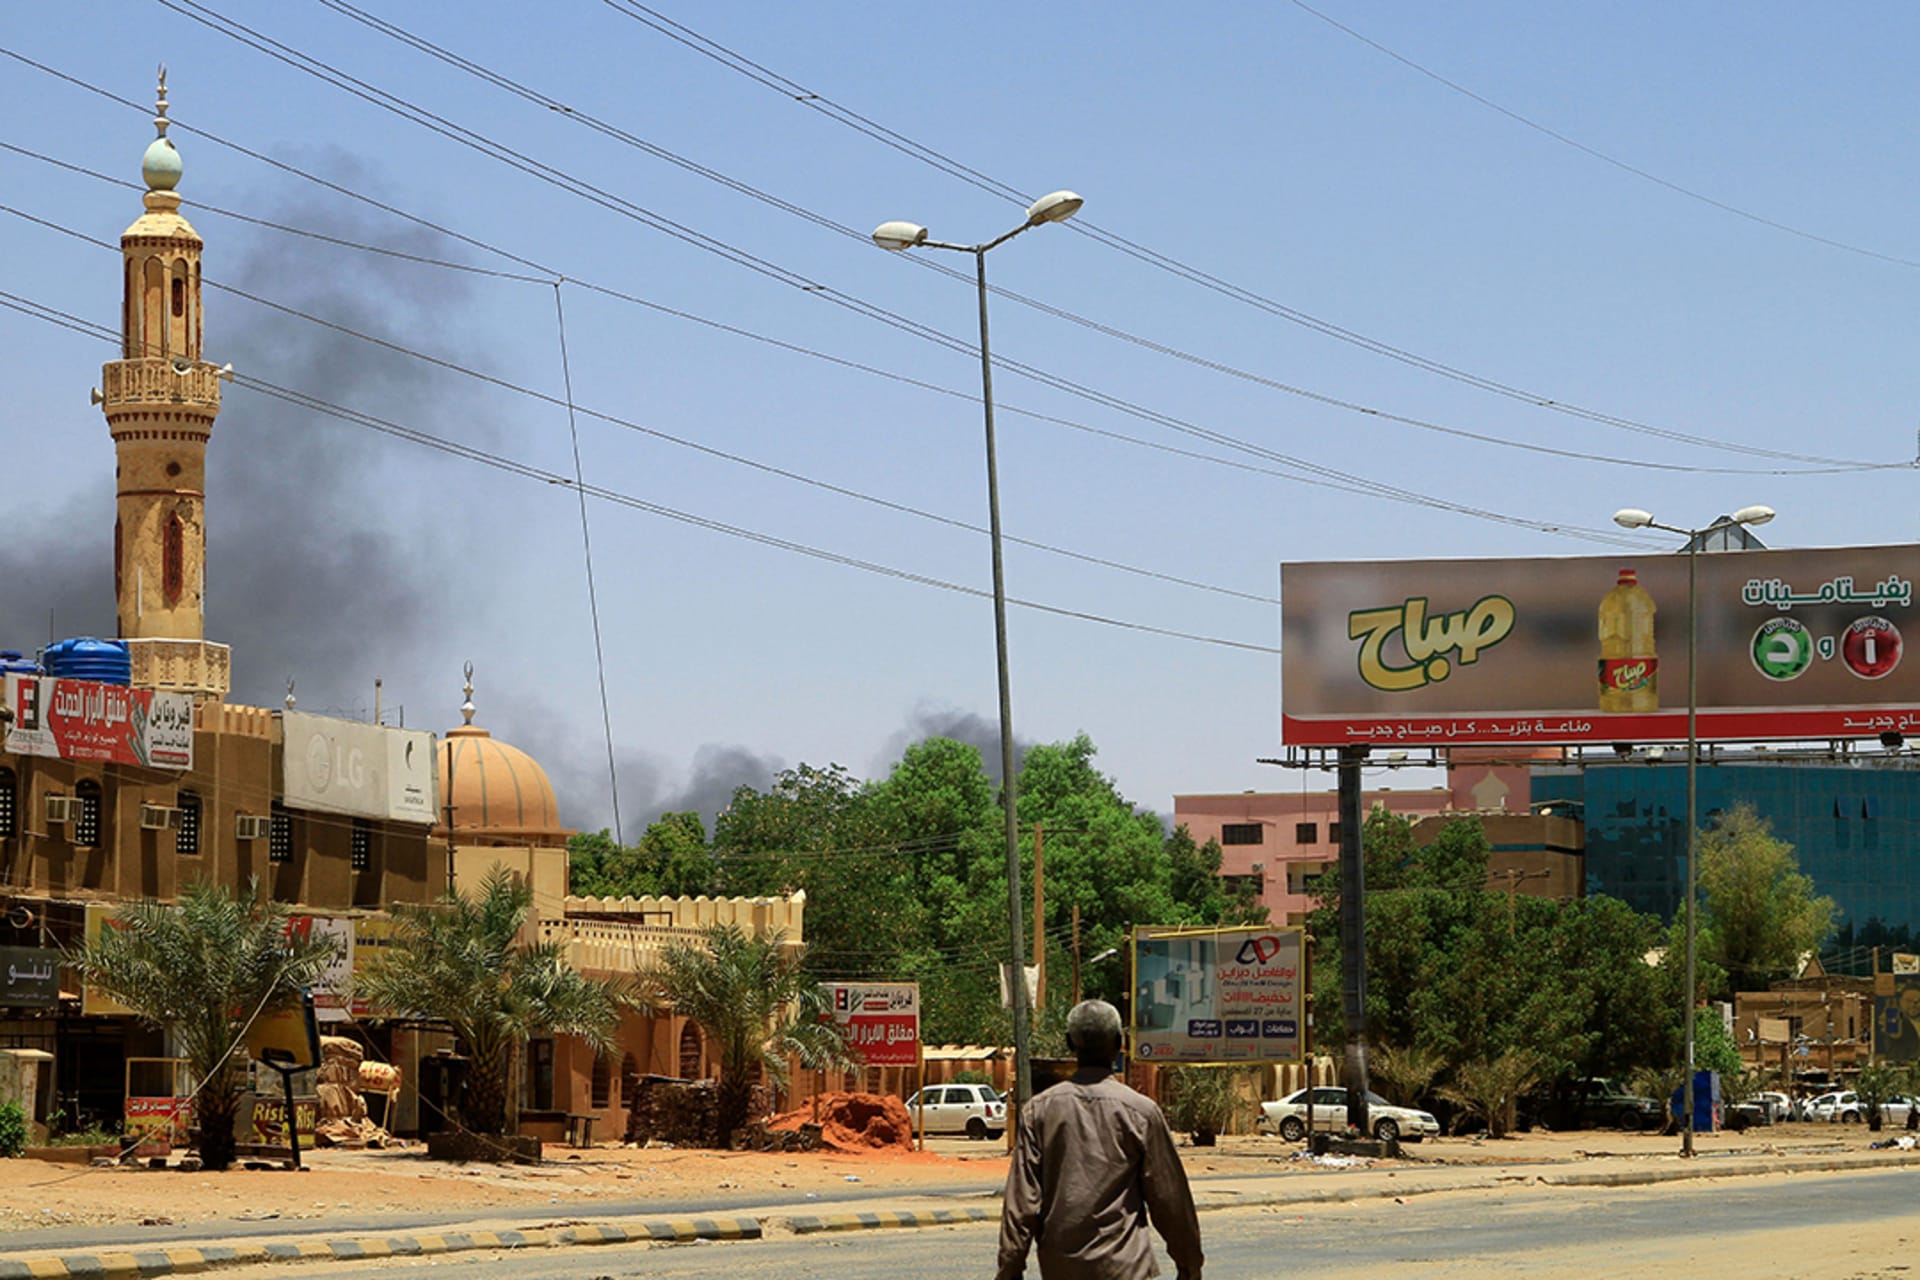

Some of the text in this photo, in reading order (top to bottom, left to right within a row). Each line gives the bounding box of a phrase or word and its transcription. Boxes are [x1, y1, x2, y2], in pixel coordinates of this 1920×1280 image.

[1743, 575, 1911, 609] بفيتامينات
[1348, 594, 1516, 692] صباح
[1446, 721, 1476, 737] كل
[1535, 720, 1592, 735] مناعة
[1843, 715, 1895, 730] جديد
[1345, 724, 1394, 739] جديد
[1396, 723, 1443, 739] صباح
[336, 745, 364, 789] LG
[886, 1022, 915, 1046] مغلق
